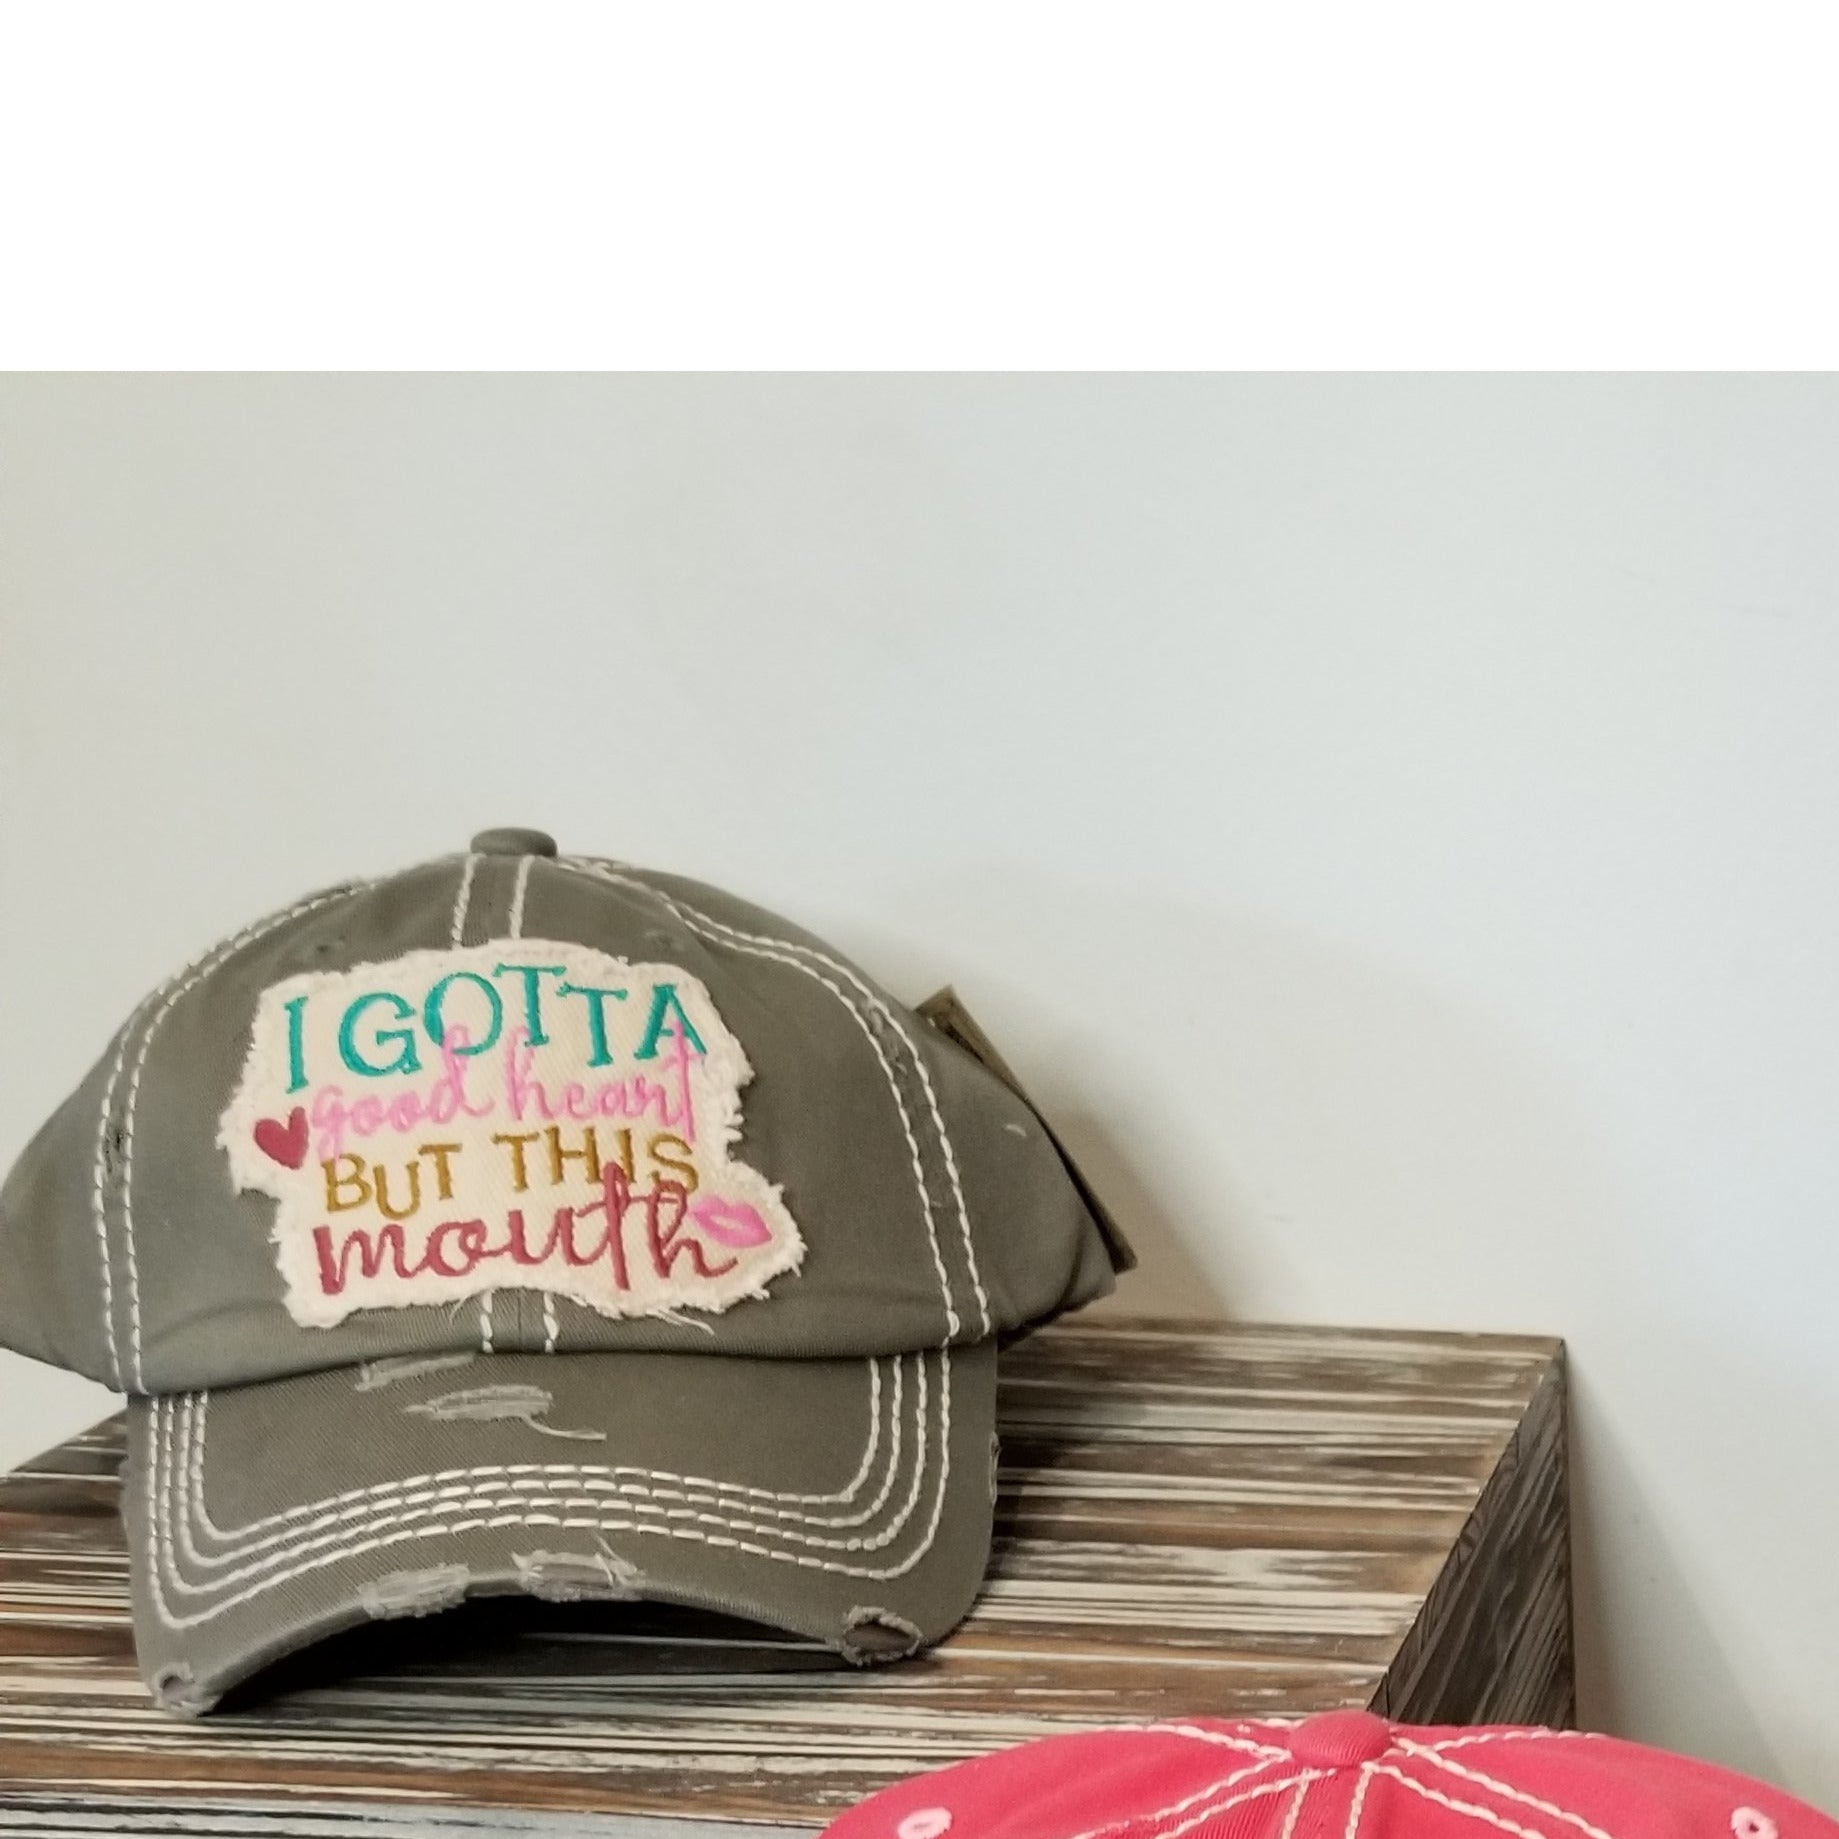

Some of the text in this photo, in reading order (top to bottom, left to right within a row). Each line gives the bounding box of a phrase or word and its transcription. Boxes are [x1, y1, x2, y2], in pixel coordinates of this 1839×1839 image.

[285, 963, 707, 1094] I GOTTA
[312, 1019, 699, 1160] good heart
[313, 1161, 737, 1294] mouth
[322, 1126, 699, 1220] BUT THIS
